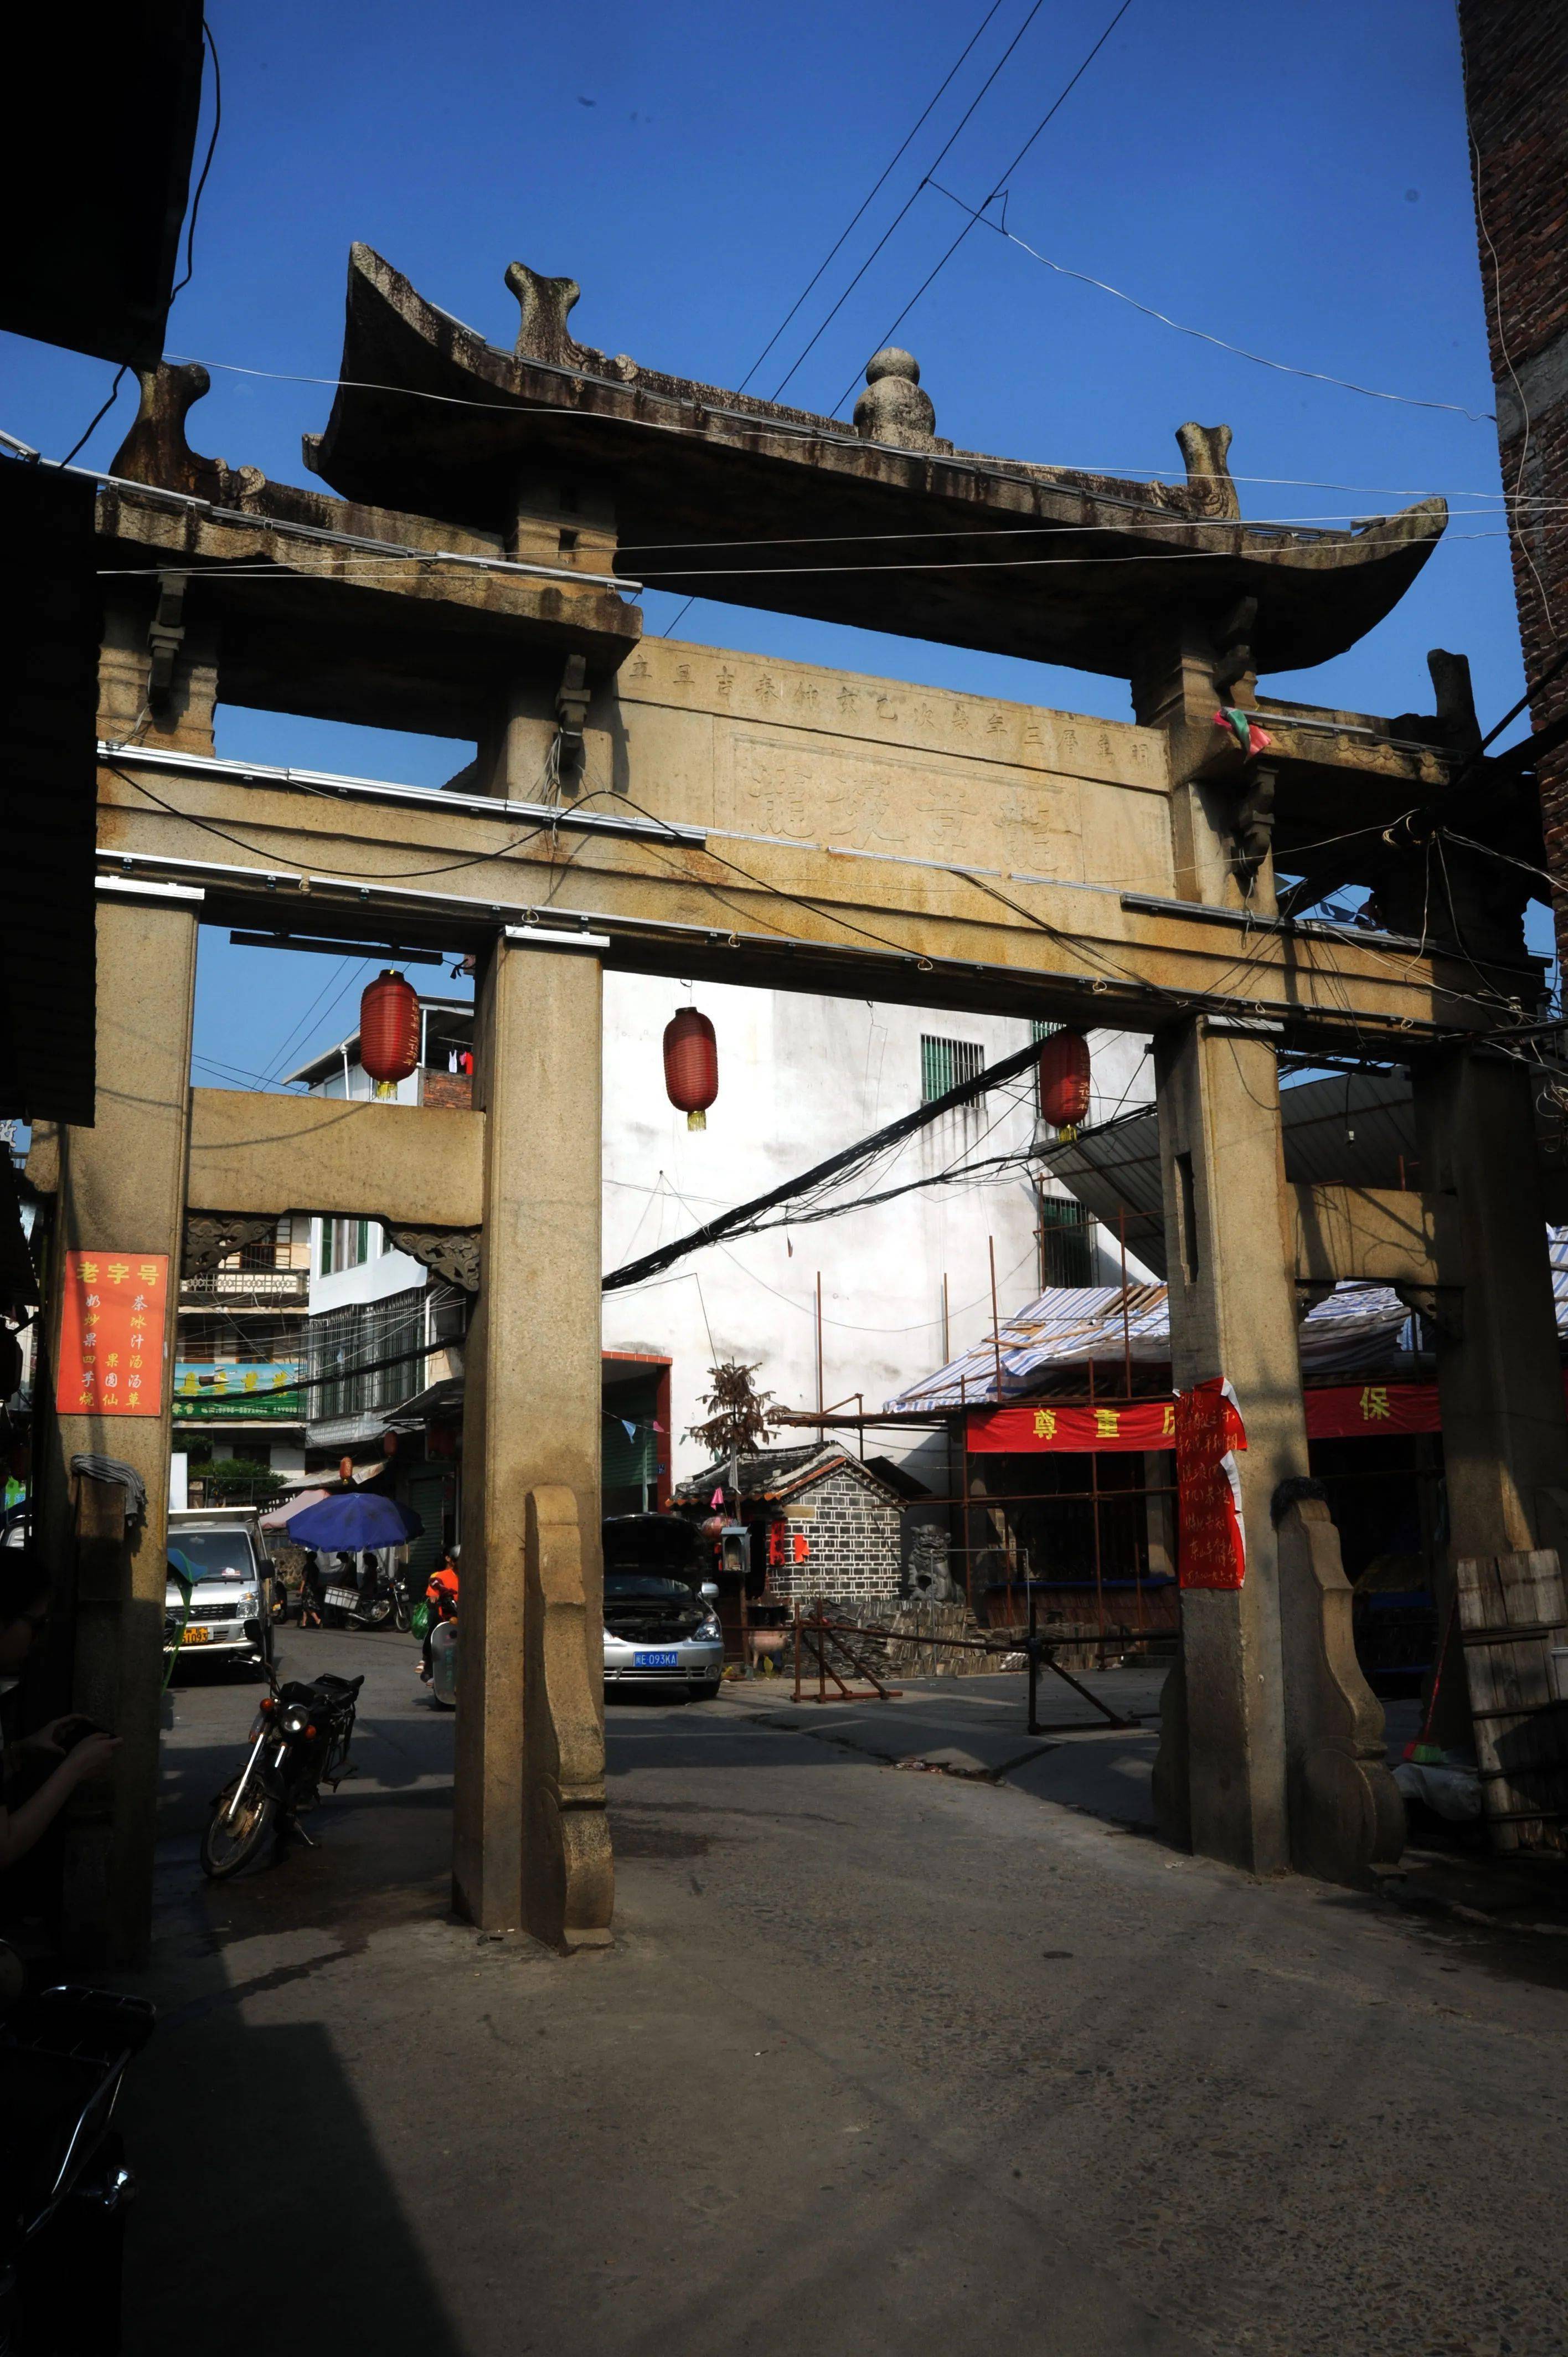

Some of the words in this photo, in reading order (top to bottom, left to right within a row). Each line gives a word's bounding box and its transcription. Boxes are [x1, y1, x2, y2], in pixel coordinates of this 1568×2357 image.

[76, 1261, 159, 1286] 老字号
[1359, 1387, 1391, 1420] 保
